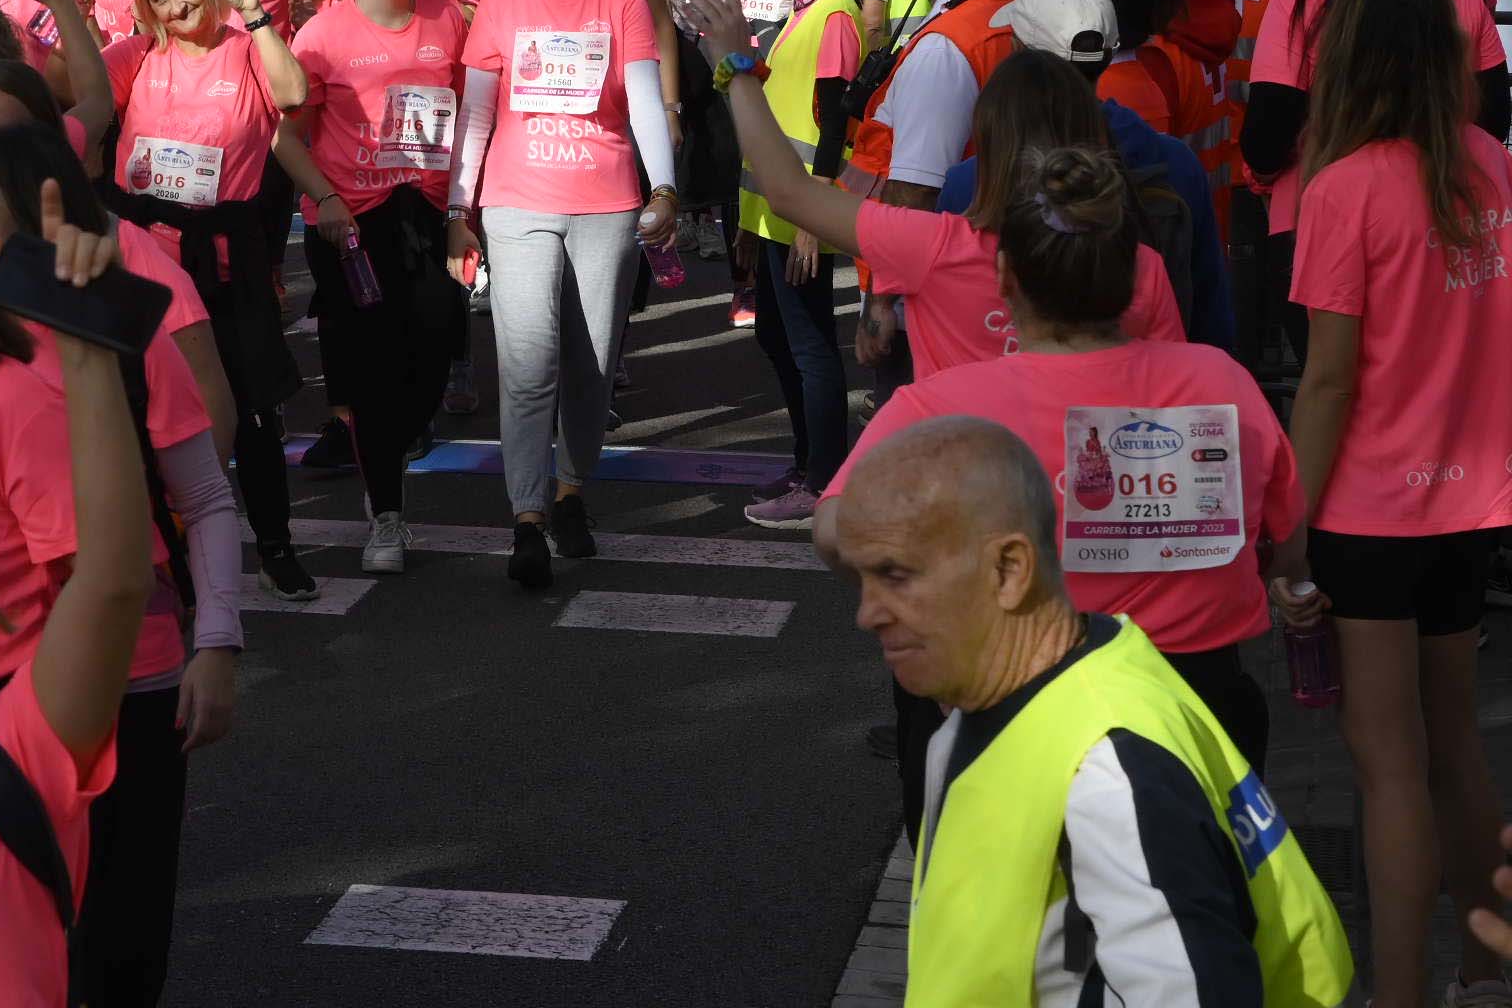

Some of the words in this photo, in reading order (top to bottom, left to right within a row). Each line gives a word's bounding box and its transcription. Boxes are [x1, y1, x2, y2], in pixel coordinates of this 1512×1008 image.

[350, 54, 389, 67] OYSHO
[545, 63, 576, 75] 016
[395, 119, 424, 131] 016
[528, 141, 594, 162] SUMA
[154, 173, 185, 188] 016
[356, 169, 422, 189] SUMA
[1190, 428, 1225, 438] SUMA
[1114, 437, 1178, 451] ASTURIANA
[1119, 473, 1178, 496] 016
[1124, 504, 1172, 518] 27213
[1083, 526, 1128, 535] CARRERA
[1130, 526, 1144, 535] DE
[1146, 526, 1160, 535] LA
[1162, 525, 1197, 535] MUJER
[1201, 524, 1225, 533] 2023
[1078, 547, 1129, 561] OYSHO
[1175, 545, 1231, 558] Santander
